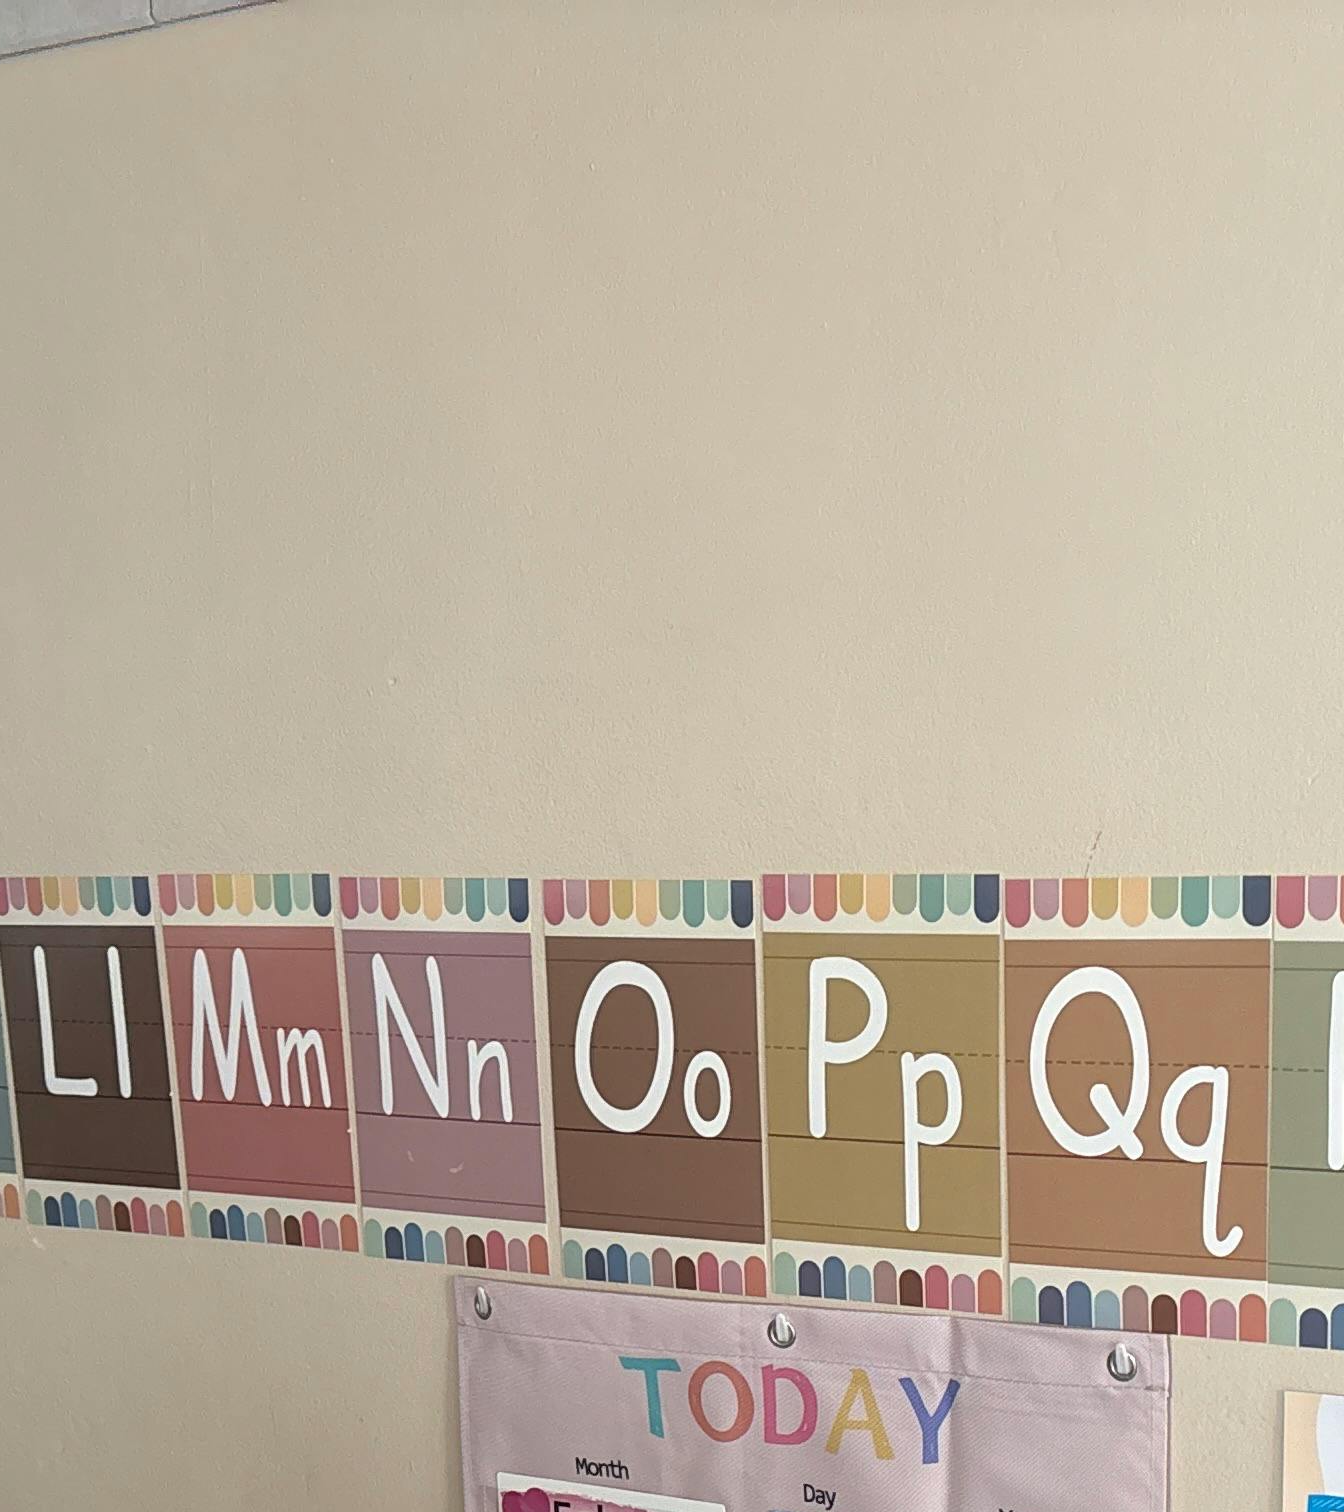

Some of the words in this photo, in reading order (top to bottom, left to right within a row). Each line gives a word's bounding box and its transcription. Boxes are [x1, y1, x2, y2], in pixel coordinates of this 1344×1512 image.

[191, 947, 331, 1108] Mm
[371, 952, 514, 1123] Nn
[574, 960, 731, 1138] Oo
[808, 956, 963, 1232] Pp
[1029, 966, 1243, 1257] Qq
[575, 1457, 630, 1481] Month
[619, 1355, 961, 1465] TODAY
[802, 1484, 836, 1509] Day
